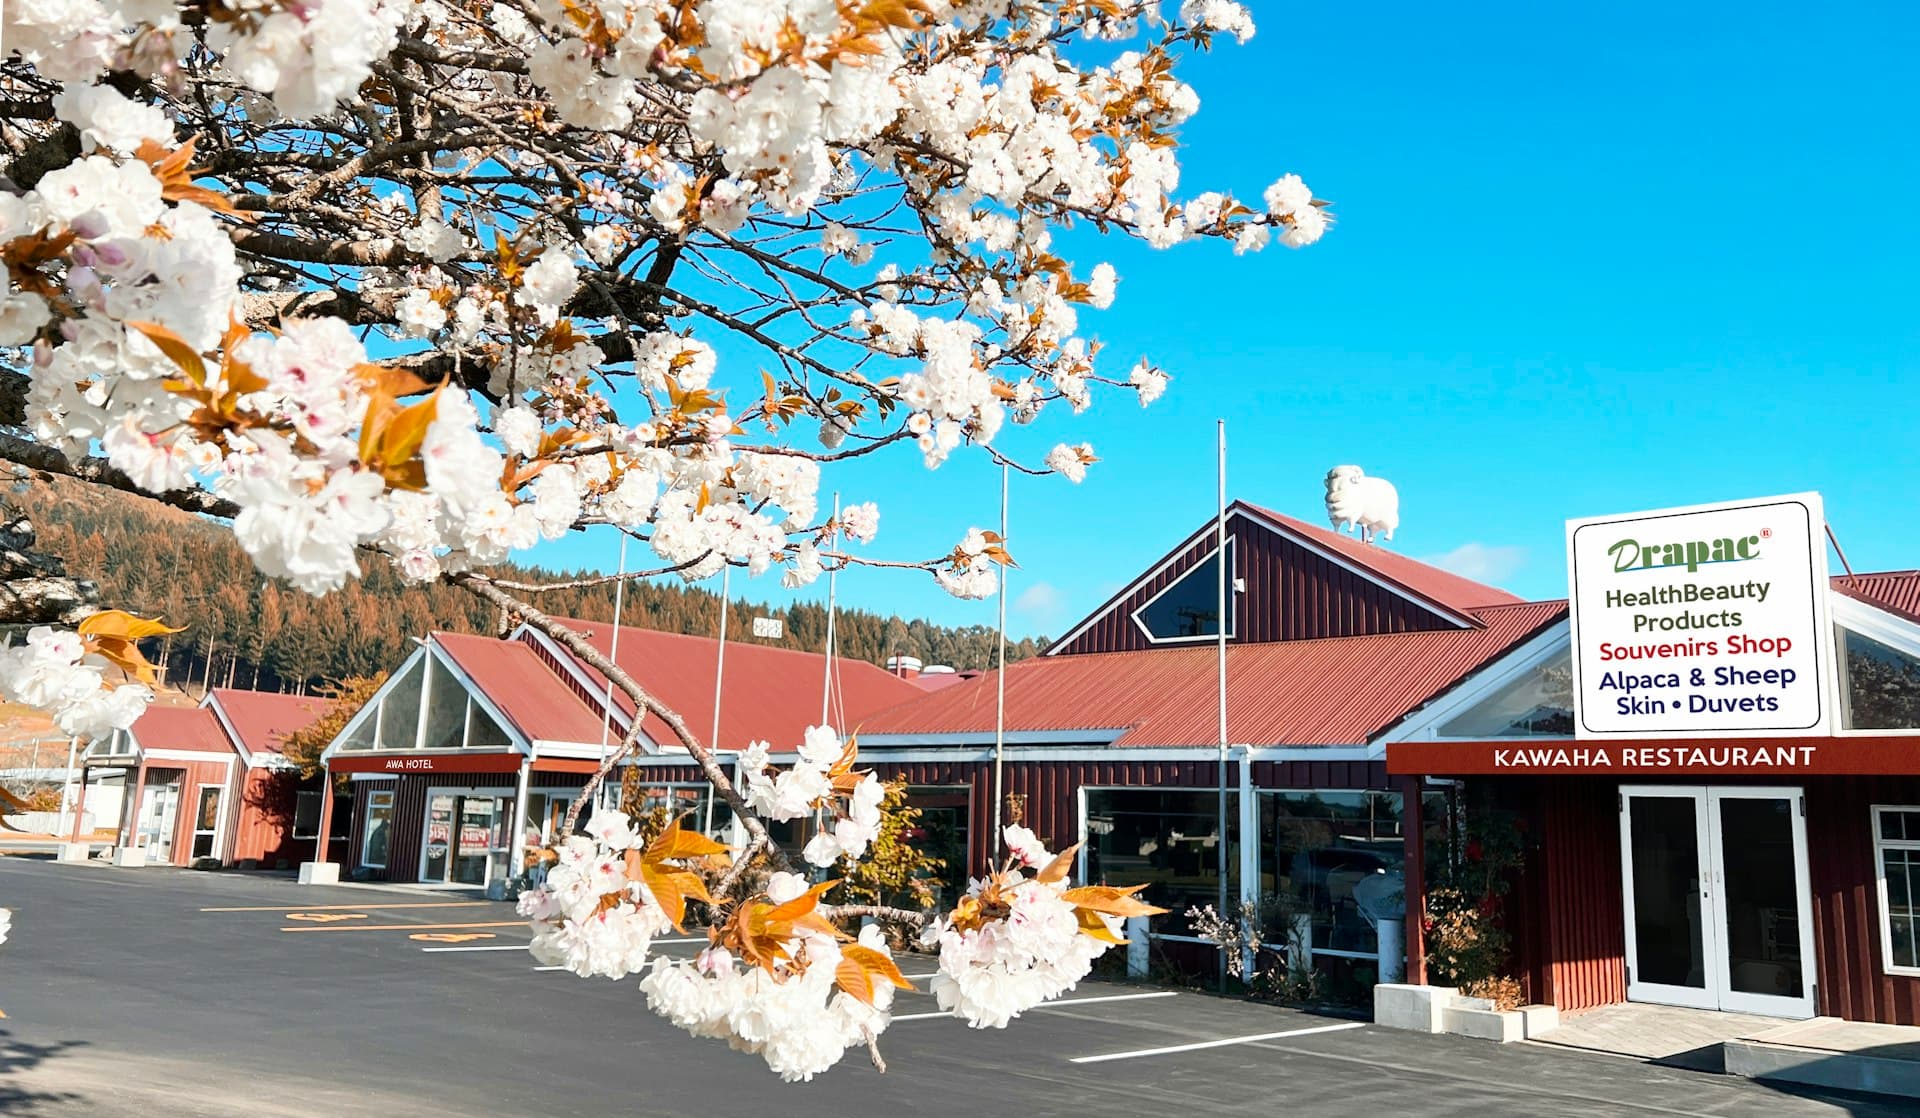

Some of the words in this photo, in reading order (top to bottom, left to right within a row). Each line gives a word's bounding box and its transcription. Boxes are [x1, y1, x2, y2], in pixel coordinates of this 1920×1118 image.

[1607, 535, 1761, 573] Drapac
[1606, 580, 1771, 609] HealthBeauty
[1633, 609, 1743, 633] Products
[1599, 637, 1719, 661] Souvenirs
[1726, 634, 1792, 658] Shop
[1598, 670, 1680, 694] Alpaca
[1689, 667, 1706, 687] &
[1714, 665, 1797, 689] Sheep
[1616, 695, 1665, 716] Skin
[1688, 693, 1779, 714] Duvets
[385, 759, 404, 769] AWA
[405, 759, 434, 769] HOTEL
[1494, 748, 1612, 767] KAWAHA
[1622, 746, 1817, 767] RESTAURANT
